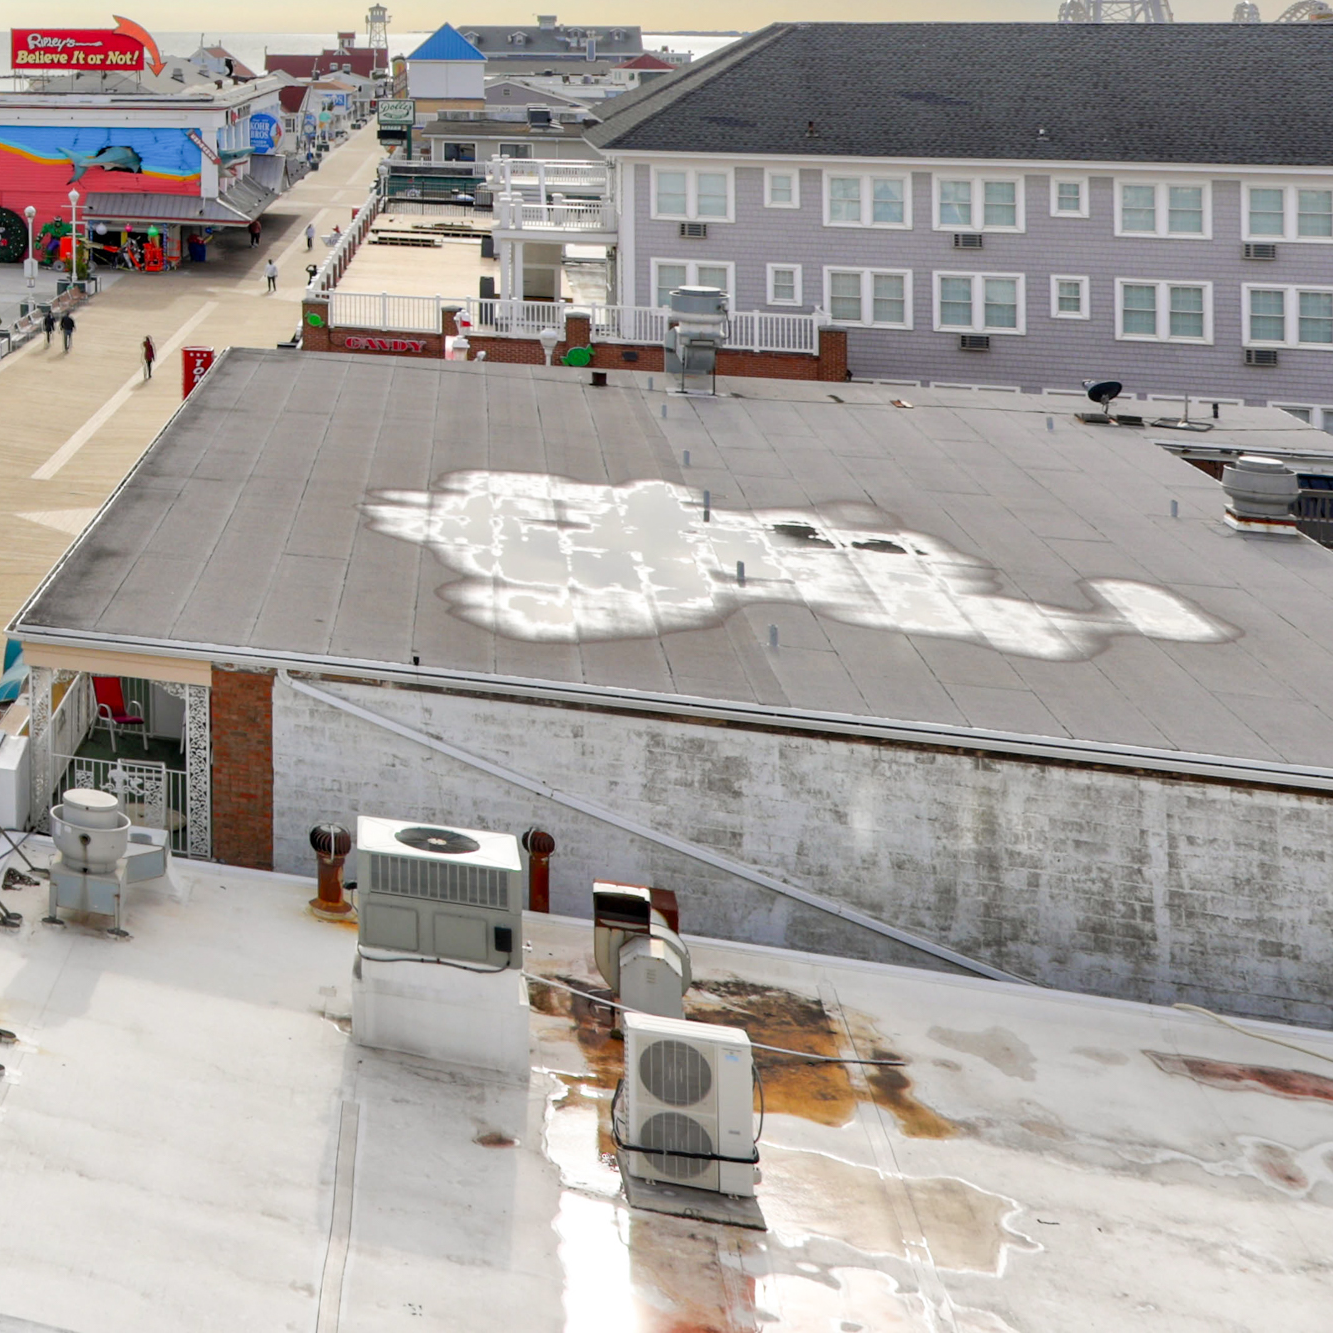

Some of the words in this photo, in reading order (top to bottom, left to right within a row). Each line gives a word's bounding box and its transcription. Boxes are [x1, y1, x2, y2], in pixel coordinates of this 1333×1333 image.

[16, 50, 68, 64] Believe
[71, 50, 85, 64] It
[87, 54, 104, 65] or
[105, 50, 140, 65] Not!
[250, 121, 270, 131] KOHR
[345, 337, 427, 353] CANDY
